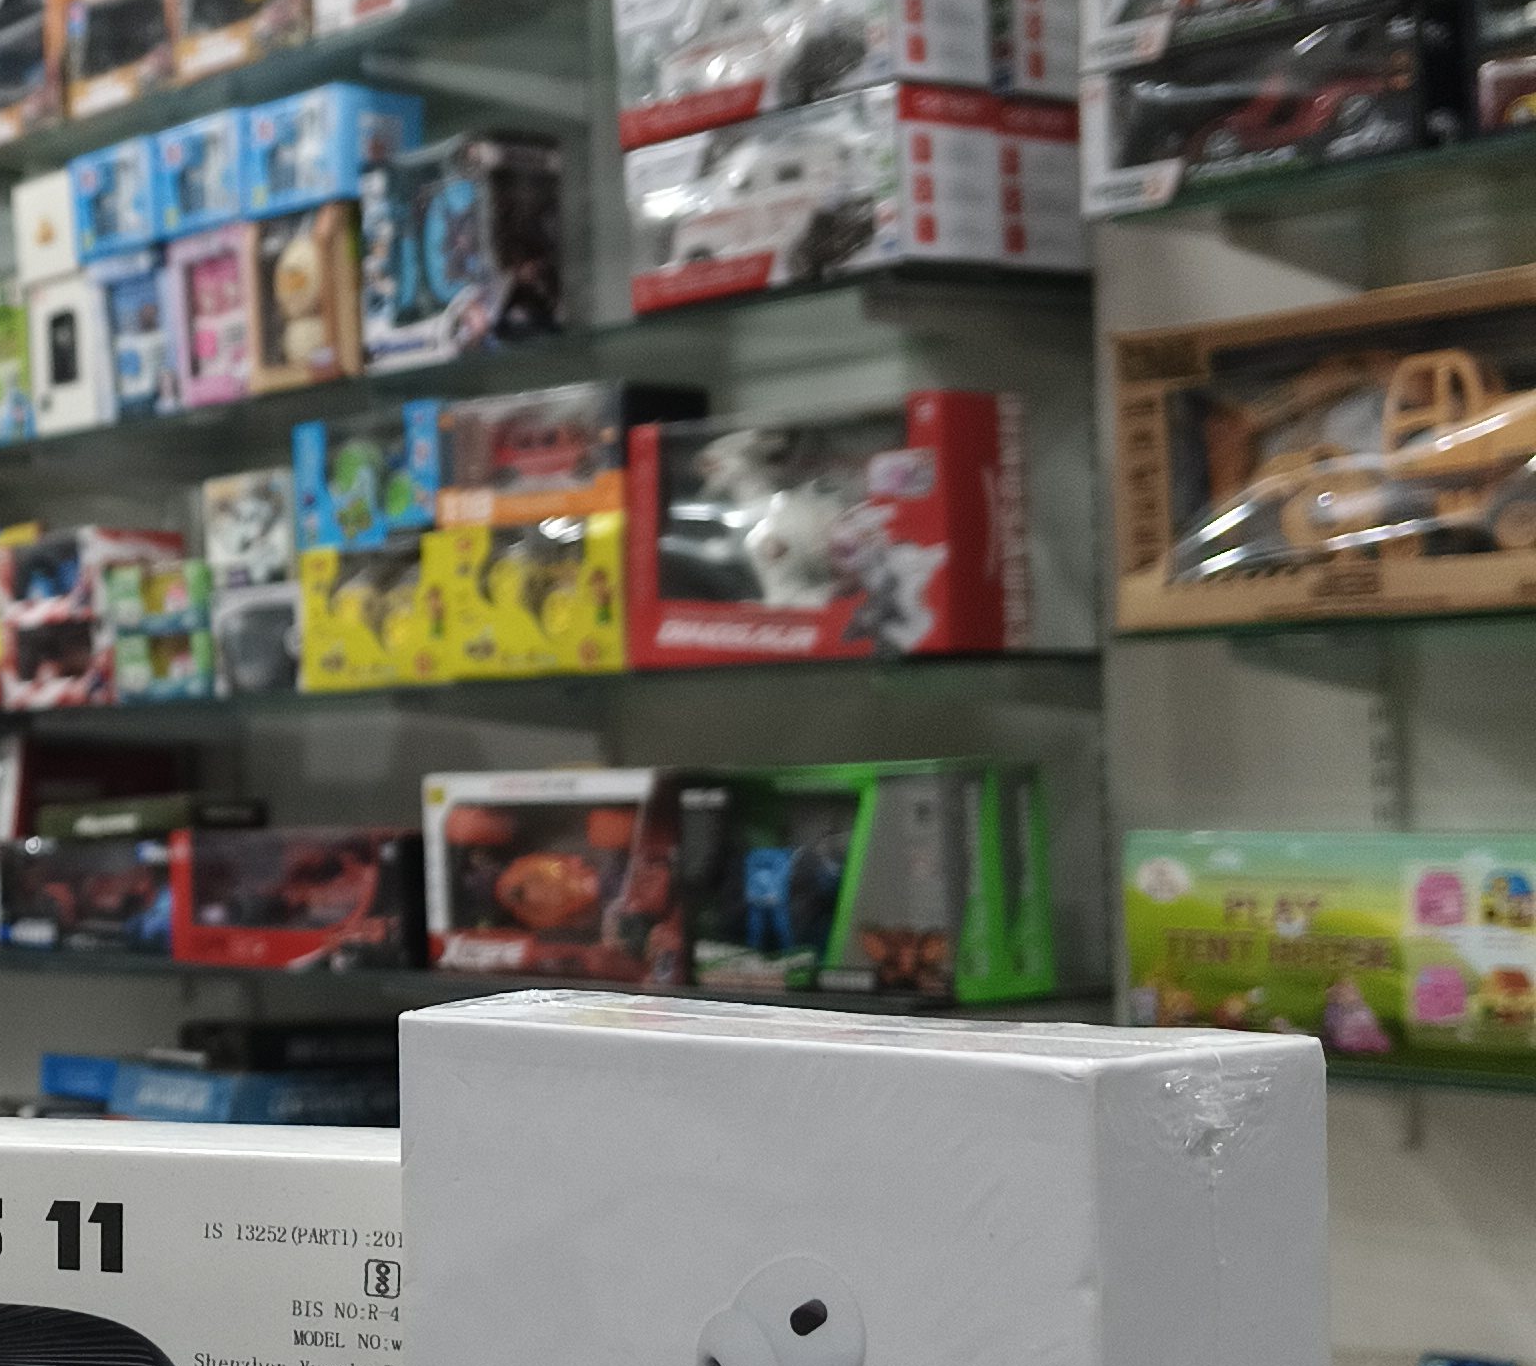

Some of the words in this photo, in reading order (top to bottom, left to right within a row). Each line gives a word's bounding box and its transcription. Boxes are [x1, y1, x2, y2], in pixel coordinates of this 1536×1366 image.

[44, 1198, 125, 1274] 11
[204, 1222, 223, 1239] IS
[292, 1299, 324, 1318] BIS
[293, 1329, 346, 1349] MODEL
